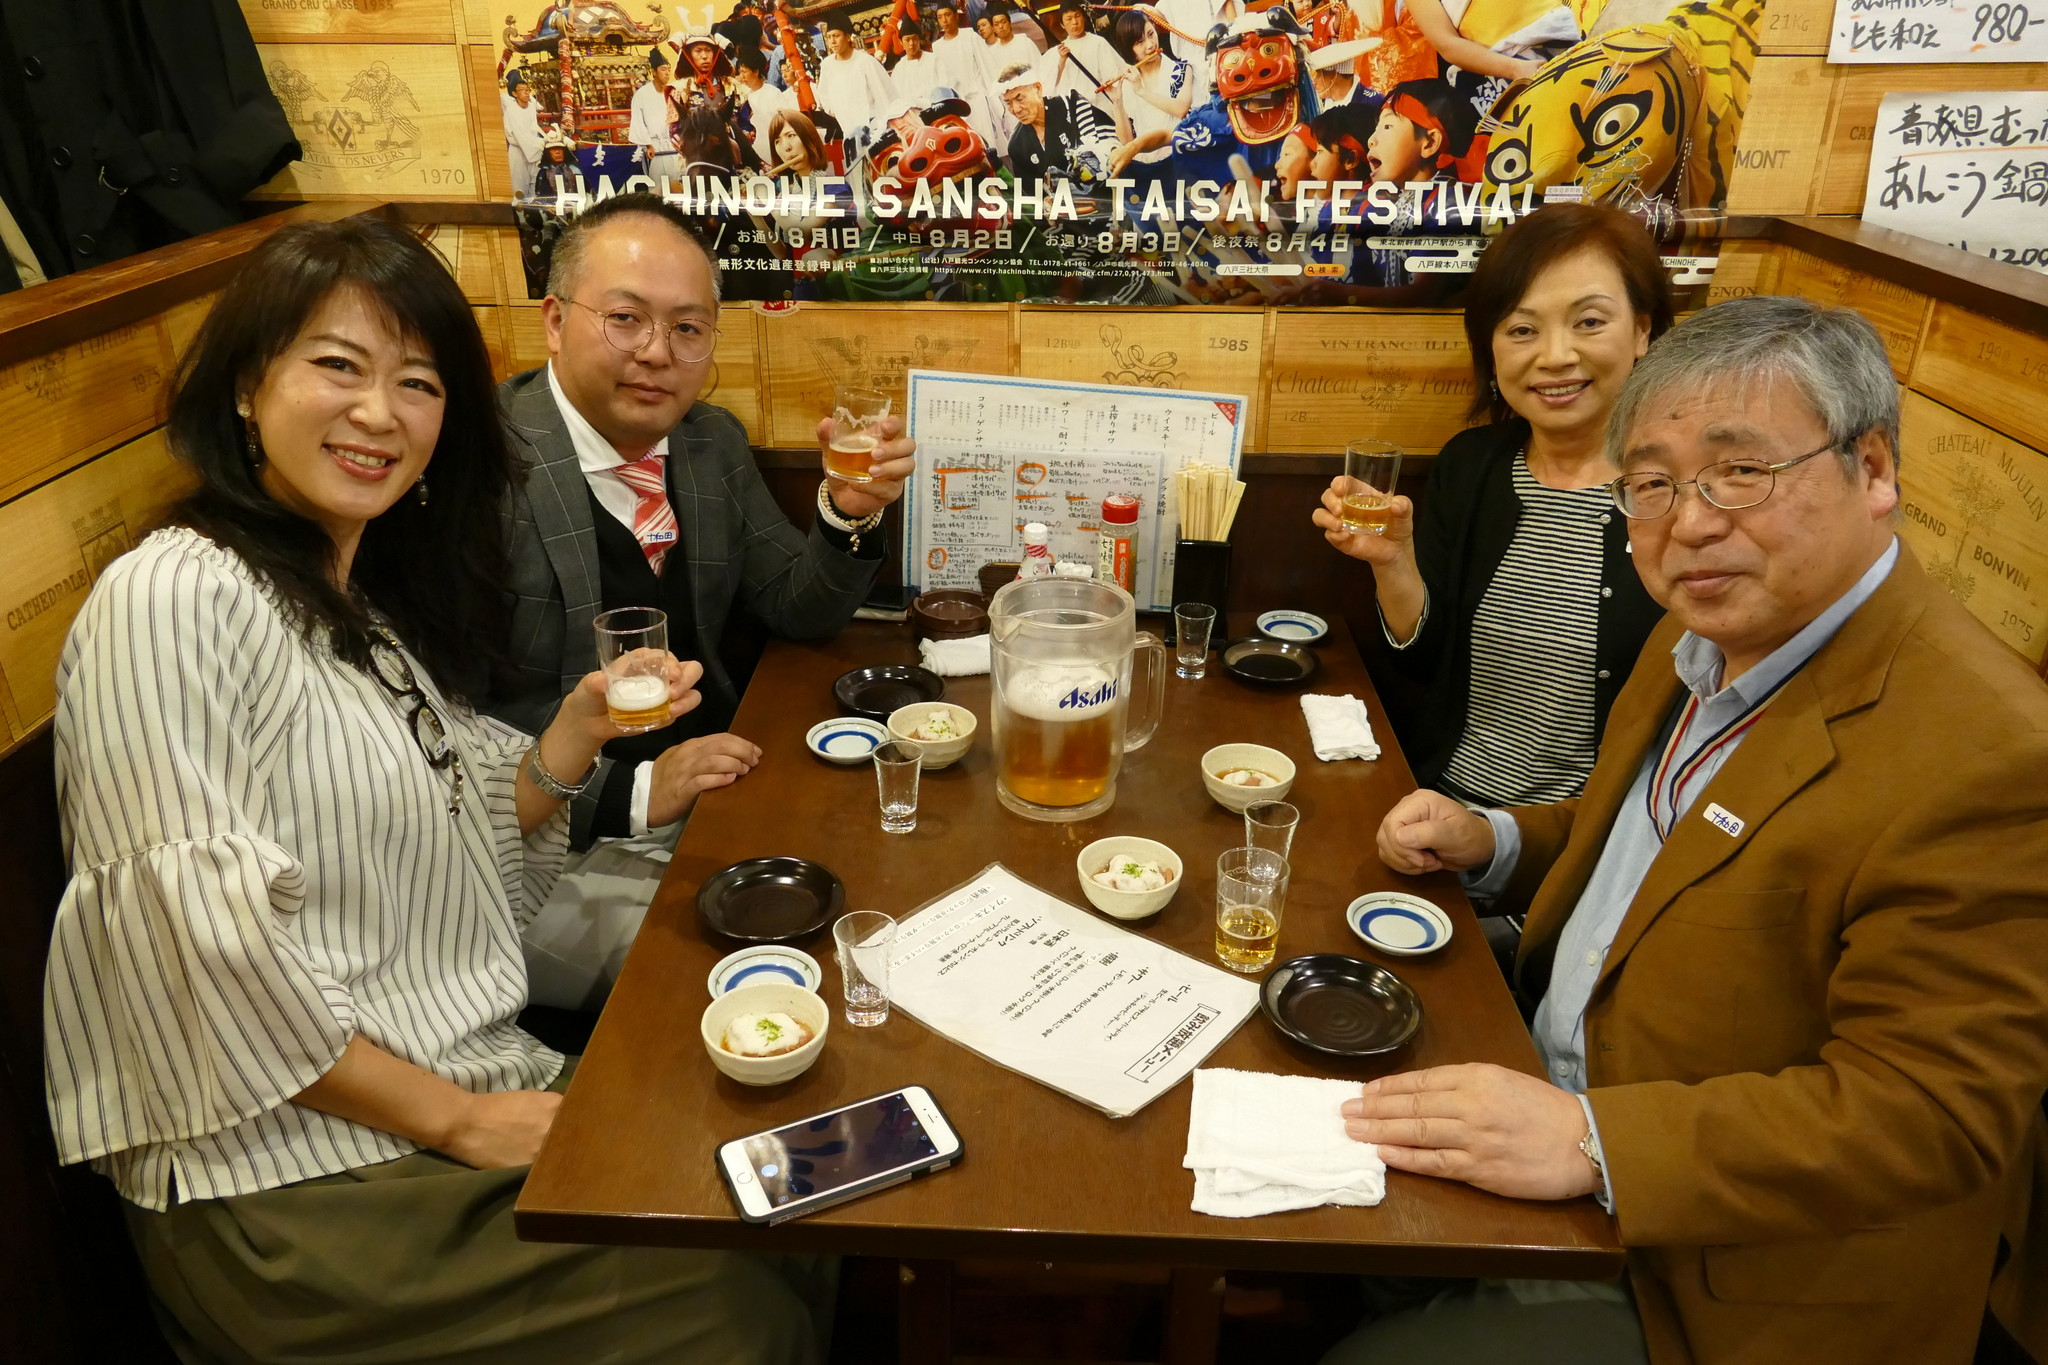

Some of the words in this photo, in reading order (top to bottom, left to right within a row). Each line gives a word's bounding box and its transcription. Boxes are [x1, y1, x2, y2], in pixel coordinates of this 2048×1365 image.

[262, 0, 297, 10] GRAND
[300, 0, 320, 10] CRU
[420, 168, 465, 185] 1970
[873, 176, 1079, 221] SANSHA
[1106, 179, 1270, 223] TAISAI
[737, 230, 779, 245] お通り
[788, 227, 861, 249] 8月1日
[892, 231, 922, 245] 中日
[930, 229, 1013, 251] 8月2日
[1097, 231, 1182, 253] 8月3日
[1211, 234, 1259, 249] 後夜祭
[1265, 232, 1350, 253] 8月4日
[718, 257, 857, 273] 無形文化遺産登録申請中
[1223, 266, 1270, 275] 八戸三社大祭
[1318, 267, 1339, 275] 検索
[1208, 337, 1249, 352] 1985
[1320, 339, 1350, 350] VIN
[1276, 370, 1358, 394] Chateau
[1161, 408, 1173, 449] ウイスキー
[1208, 412, 1219, 436] ビール
[1157, 477, 1170, 516] グラス焼酎
[1904, 502, 1948, 538] GRAND
[7, 568, 91, 633] CATHEDRALE
[1058, 678, 1118, 710] Asahi
[995, 916, 1041, 946] ソフトドリンク
[1042, 929, 1070, 948] 日本酒
[1125, 966, 1150, 985] サワー
[1166, 984, 1191, 1004] ビール
[1136, 1011, 1212, 1074] 飲み放題メニュー
